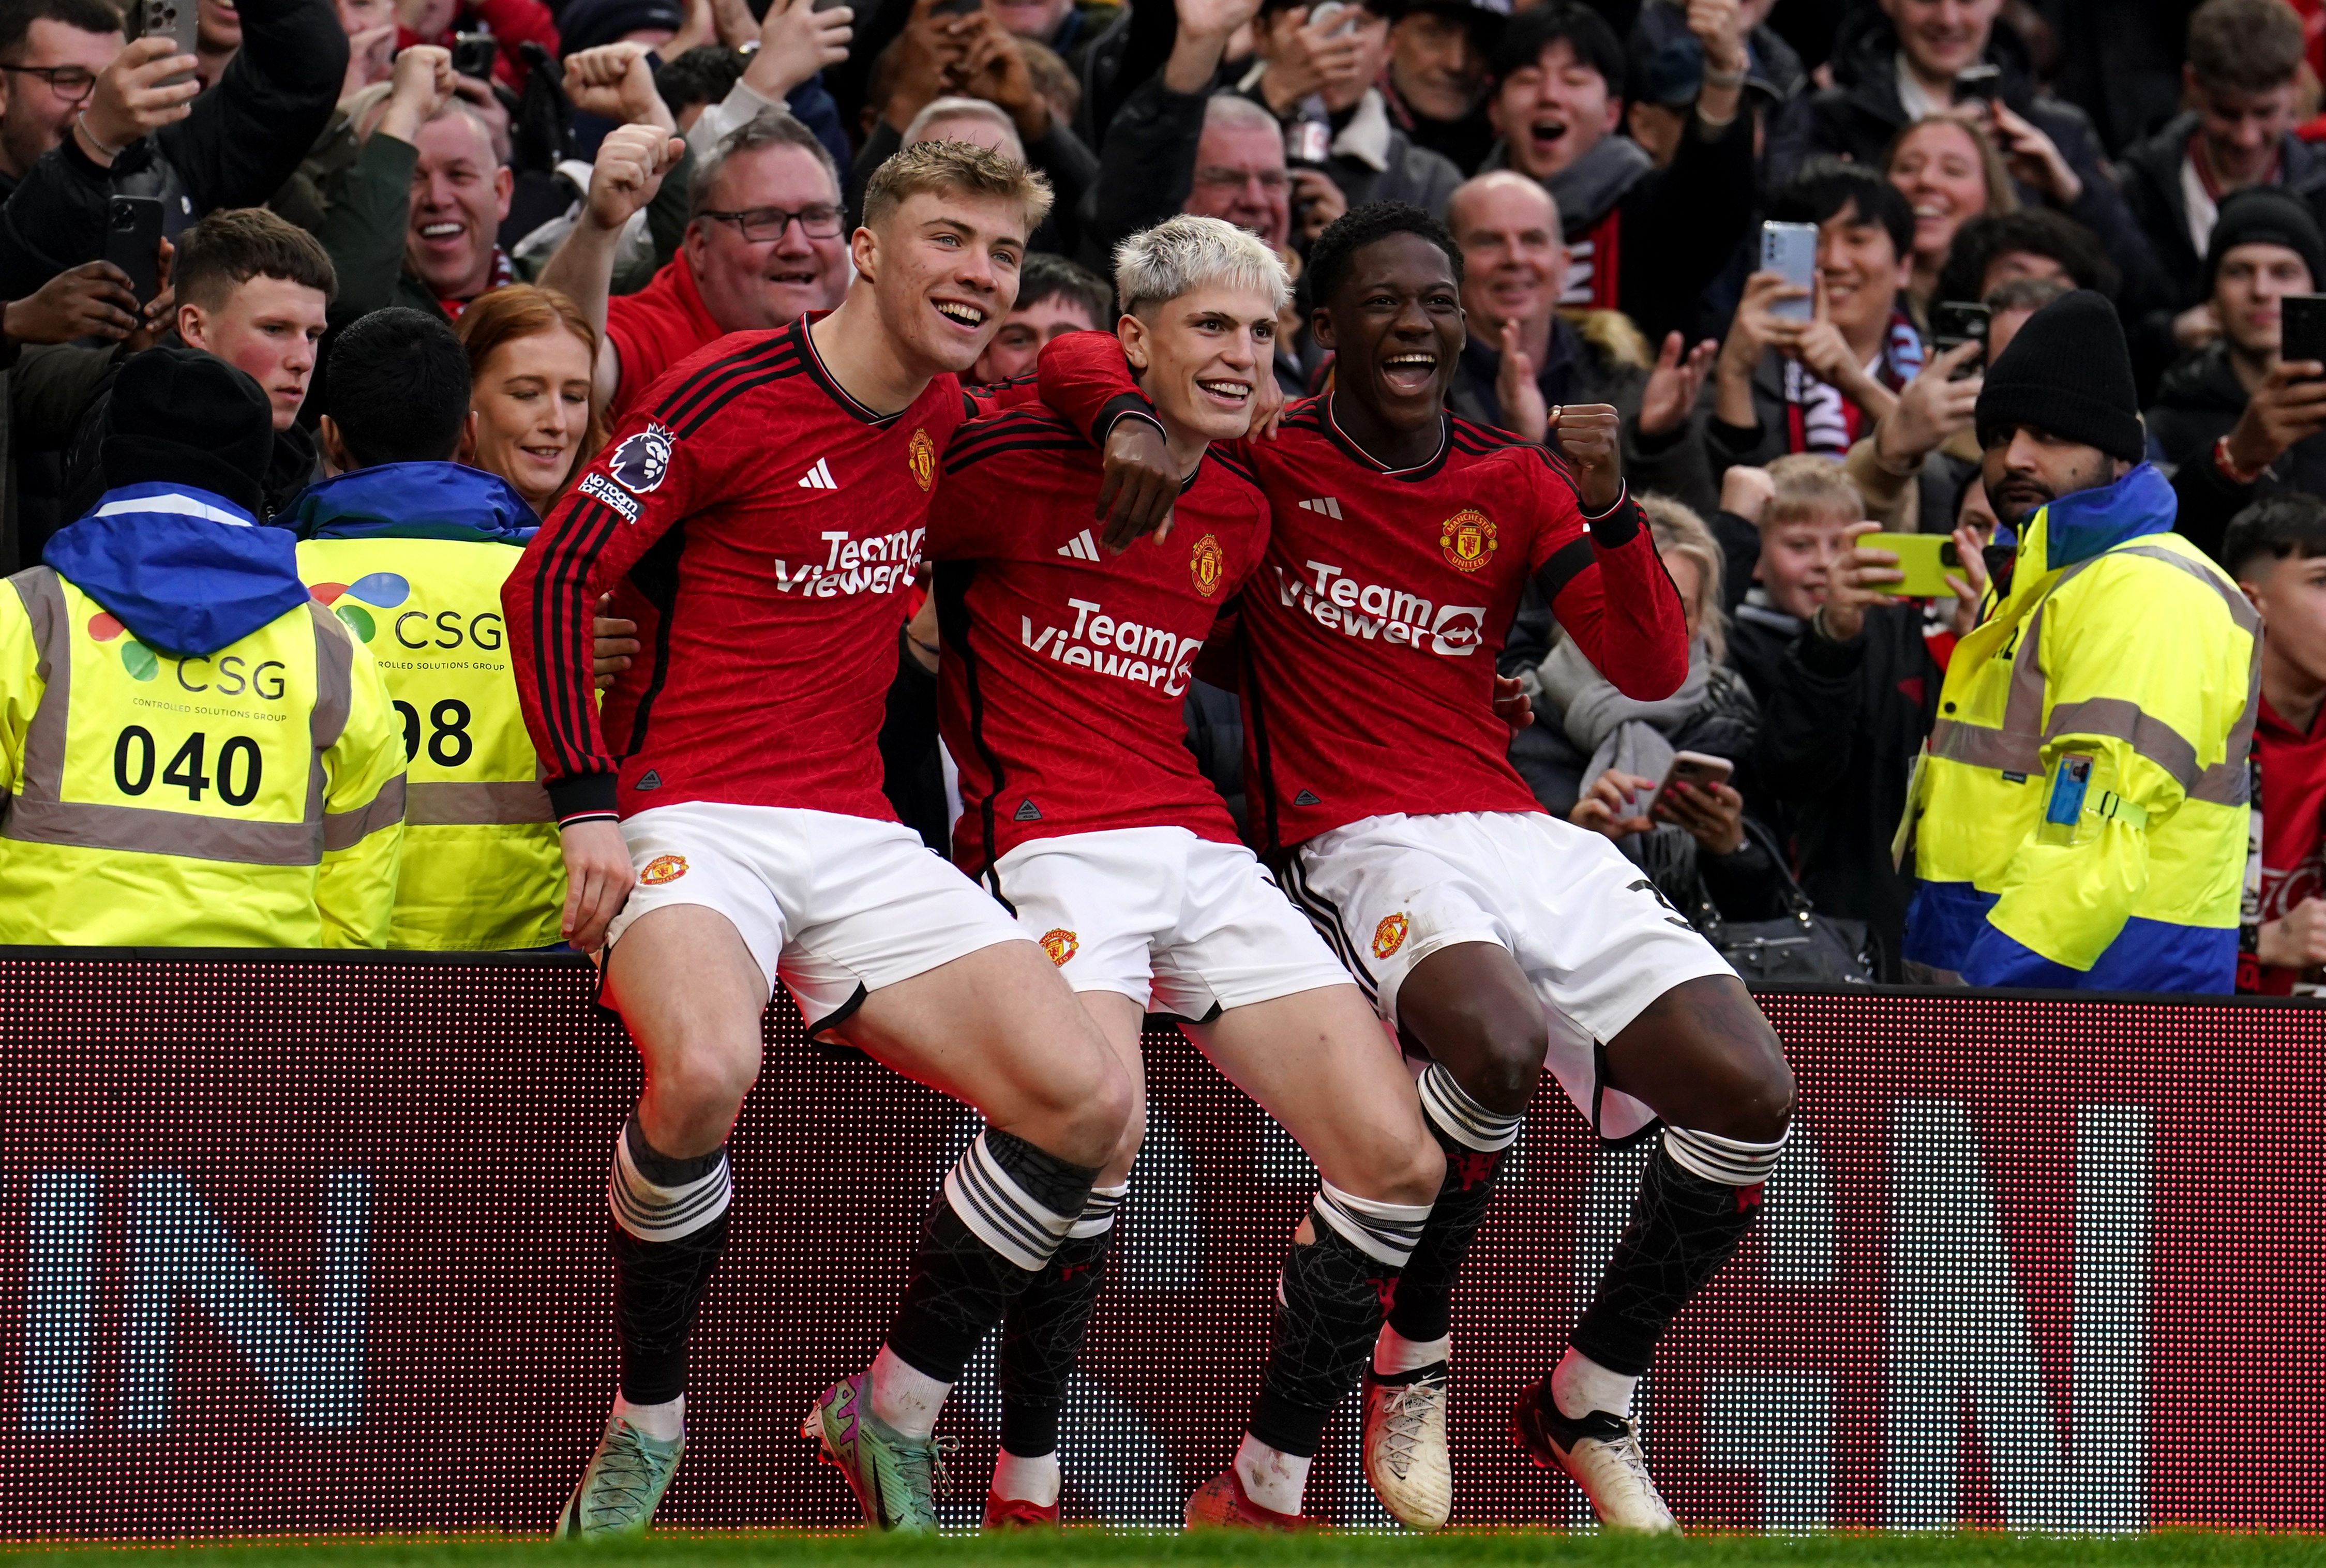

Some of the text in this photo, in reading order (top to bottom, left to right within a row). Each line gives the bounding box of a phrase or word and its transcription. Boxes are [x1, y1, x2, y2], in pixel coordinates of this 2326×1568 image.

[577, 481, 638, 525] for racism
[583, 472, 638, 513] No room
[1447, 514, 1493, 536] MANCHESTER
[821, 530, 908, 571] Team
[1452, 556, 1484, 568] UNITED
[774, 559, 905, 598] Viewer
[1196, 580, 1215, 593] UNITED
[1306, 560, 1433, 628] Team
[1273, 565, 1430, 649] Viewer
[395, 610, 502, 651] CSG
[1067, 597, 1177, 669] Team
[378, 660, 505, 671] ROLLED SOLUTIONS GROUP
[1022, 615, 1168, 688] Viewer
[177, 655, 286, 700] CSG
[133, 697, 287, 722] CONTROLLED SOLUTIONS GROUP
[113, 725, 262, 807] 040
[1040, 931, 1073, 947] ANCHESTER
[1385, 934, 1404, 956] UNITED
[1056, 956, 1069, 966] TED
[20, 1170, 371, 1431] IN
